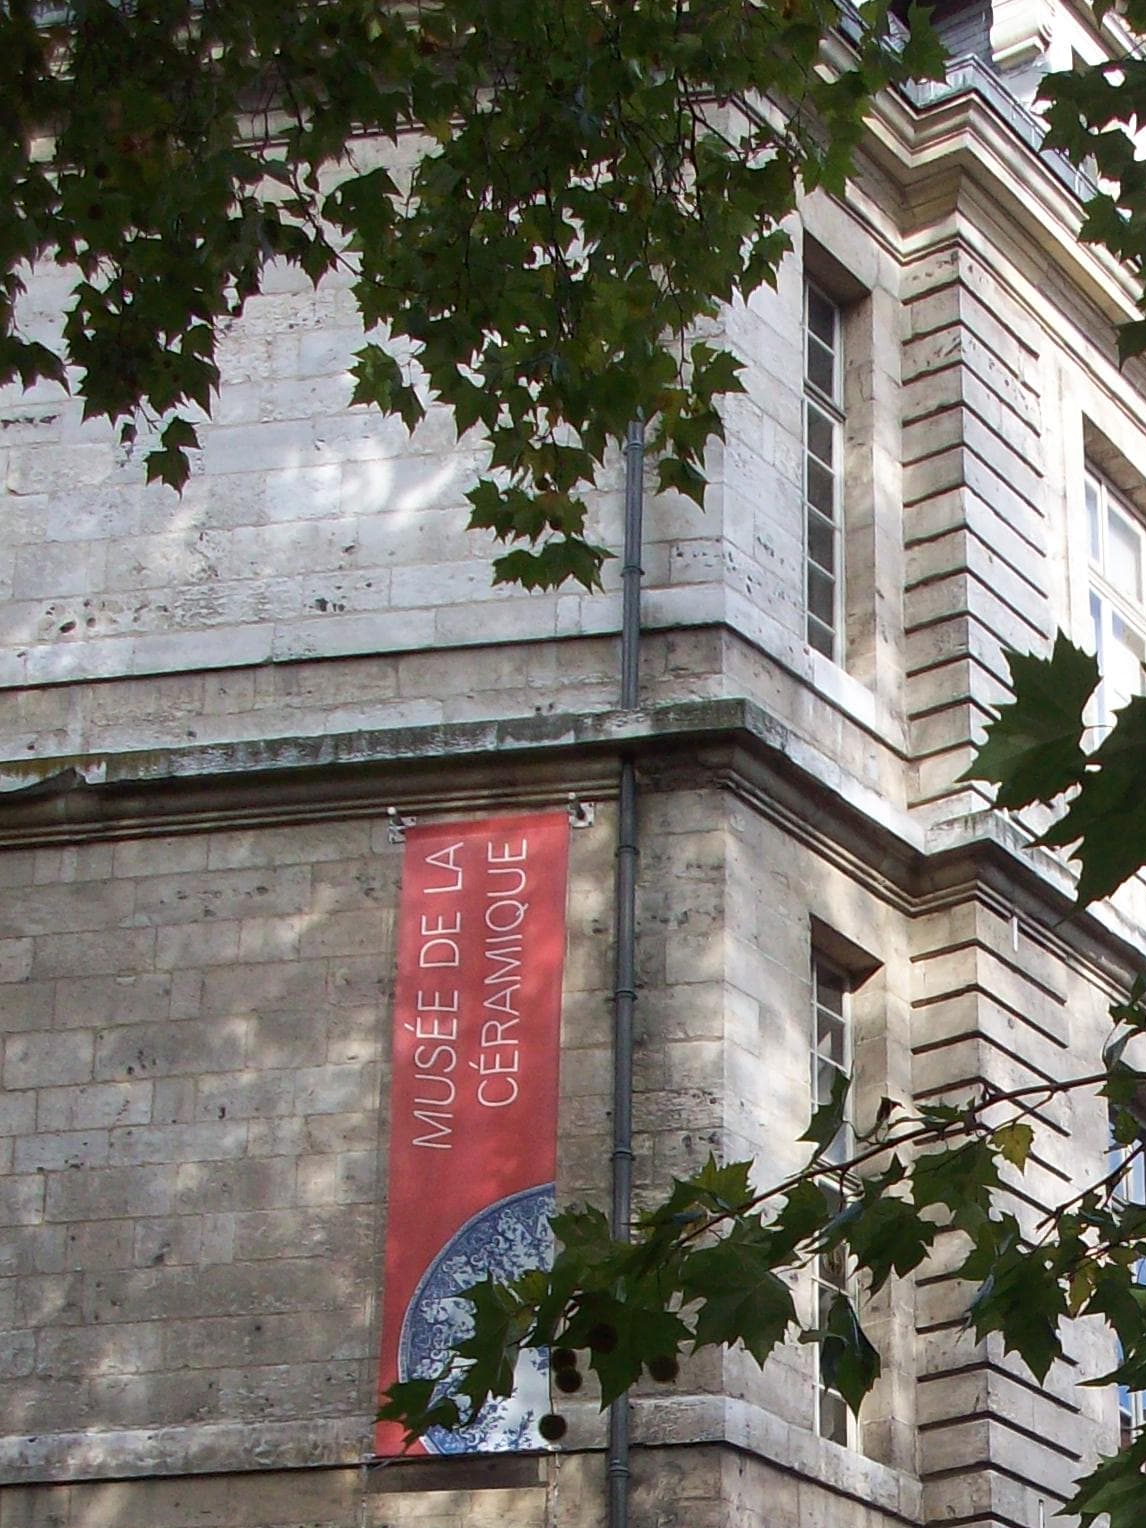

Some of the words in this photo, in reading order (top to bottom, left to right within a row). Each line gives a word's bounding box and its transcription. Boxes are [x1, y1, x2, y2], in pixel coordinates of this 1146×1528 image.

[423, 841, 465, 894] LA
[419, 911, 461, 969] DE
[468, 838, 529, 1108] CÉRAMIQUE
[404, 989, 459, 1150] MUSÉE
